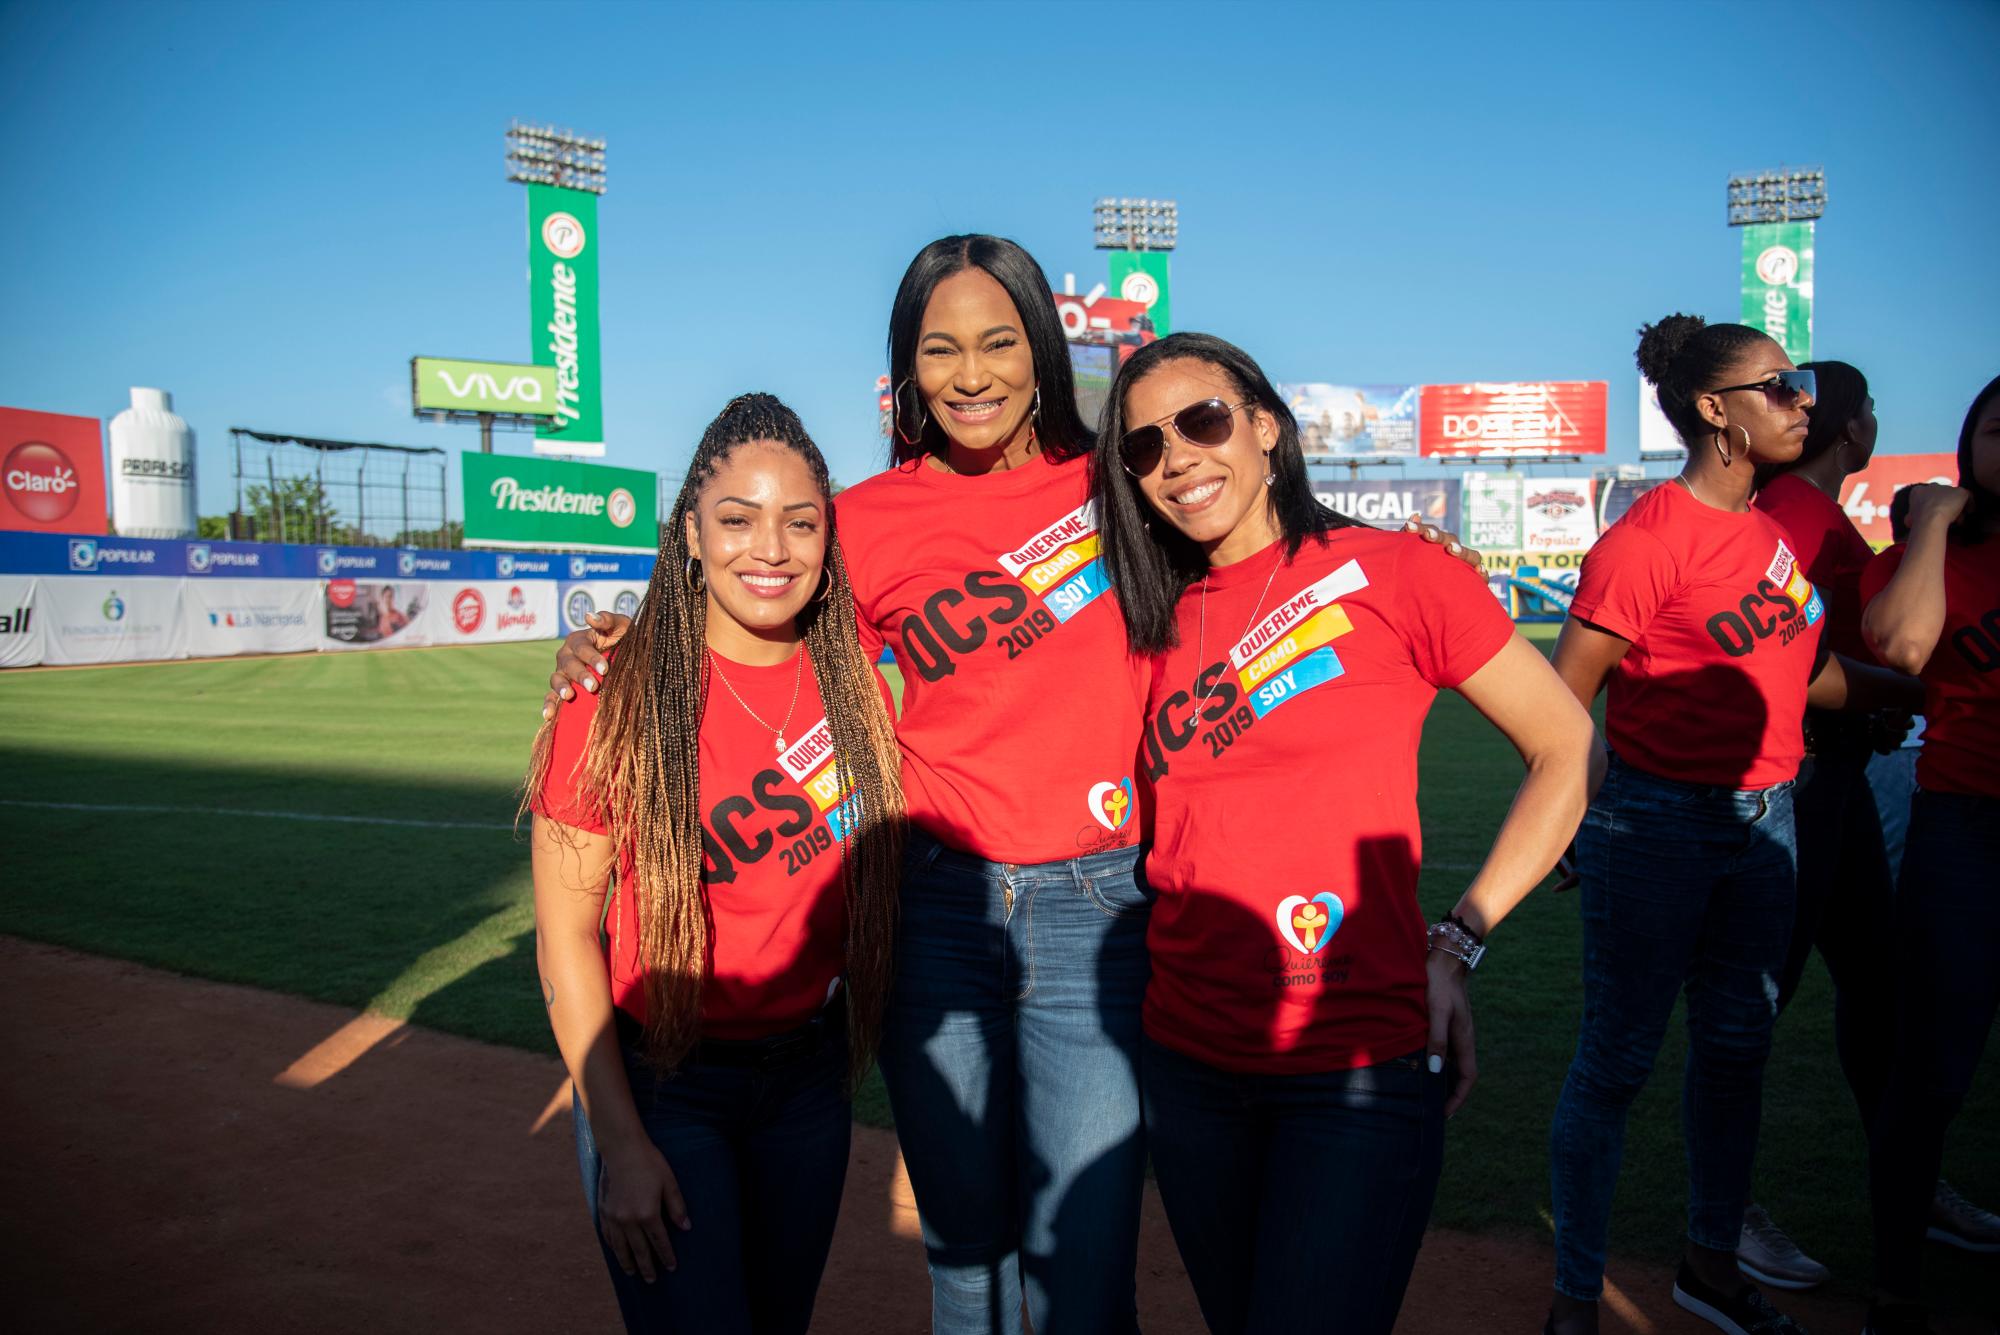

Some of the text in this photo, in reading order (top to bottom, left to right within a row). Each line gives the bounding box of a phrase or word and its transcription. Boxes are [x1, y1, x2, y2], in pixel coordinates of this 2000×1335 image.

[548, 262, 580, 427] Presidente
[6, 467, 76, 493] Claro
[490, 477, 605, 516] Presidente
[97, 549, 155, 563] POPULAR
[1009, 516, 1088, 565] QUIEREME
[1031, 549, 1081, 585] COMO
[1054, 575, 1092, 611] SOY
[901, 571, 1028, 683] QCS
[997, 608, 1056, 660] 2019
[1239, 589, 1319, 659] QUIEREME
[1706, 579, 1798, 657] QCS
[1778, 615, 1808, 647] 2019
[1248, 637, 1298, 681] COMO
[1258, 670, 1297, 706] SOY
[1141, 661, 1238, 785] QCS
[1202, 705, 1254, 760] 2019
[779, 825, 832, 877] 2019
[1272, 968, 1350, 988] como soy
